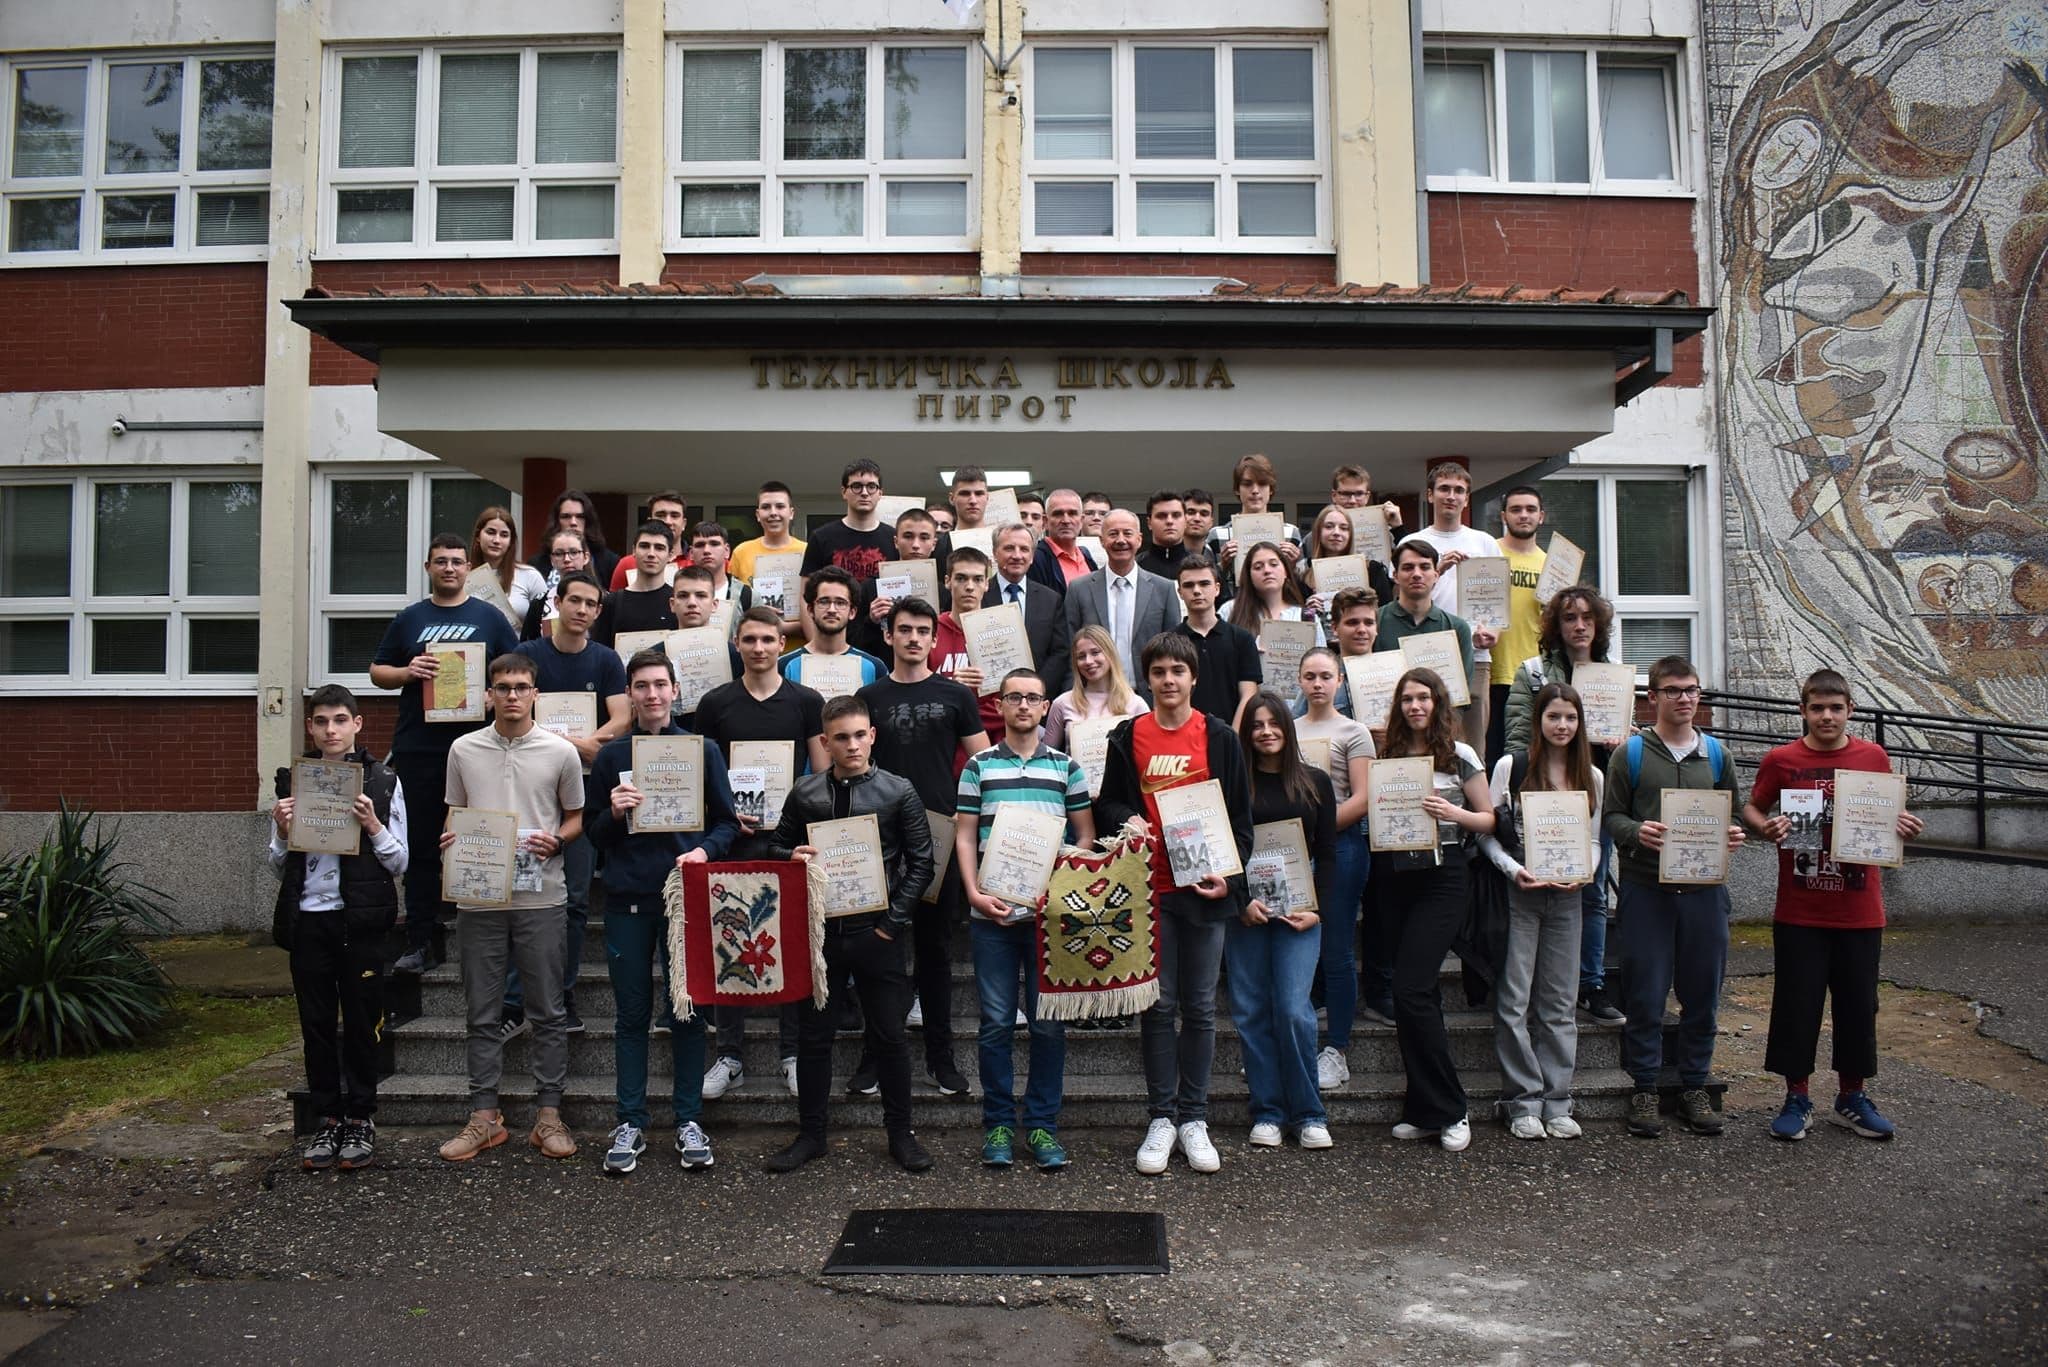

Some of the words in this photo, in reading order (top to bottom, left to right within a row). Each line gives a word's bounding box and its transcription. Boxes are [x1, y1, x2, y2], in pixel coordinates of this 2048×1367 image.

[750, 356, 1022, 389] ТЕХНИЧКА
[1057, 356, 1235, 389] ШКОЛА
[917, 394, 1077, 420] ПИРОТ
[1146, 755, 1192, 776] NIKE
[1807, 877, 1844, 891] WITH
